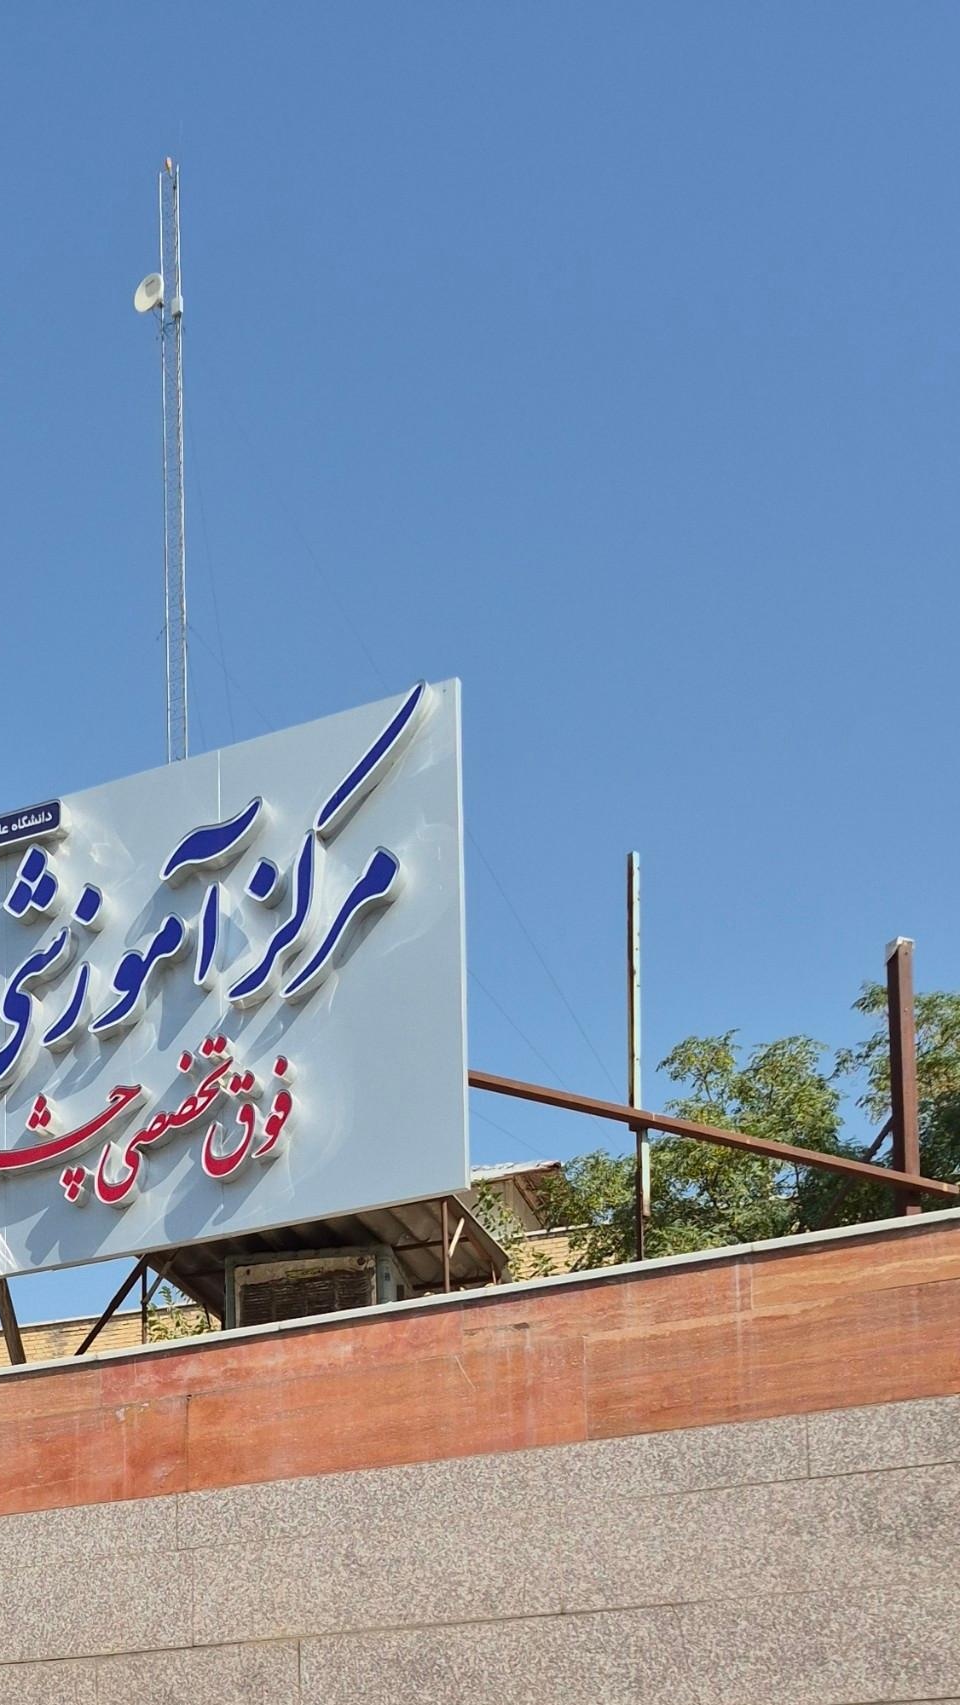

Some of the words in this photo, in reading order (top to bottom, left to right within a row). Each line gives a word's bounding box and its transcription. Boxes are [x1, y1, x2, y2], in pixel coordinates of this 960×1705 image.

[11, 811, 53, 832] دانشگاه
[226, 682, 424, 999] مرکز
[95, 1037, 230, 1204] تخصصی
[202, 1059, 293, 1179] فوق
